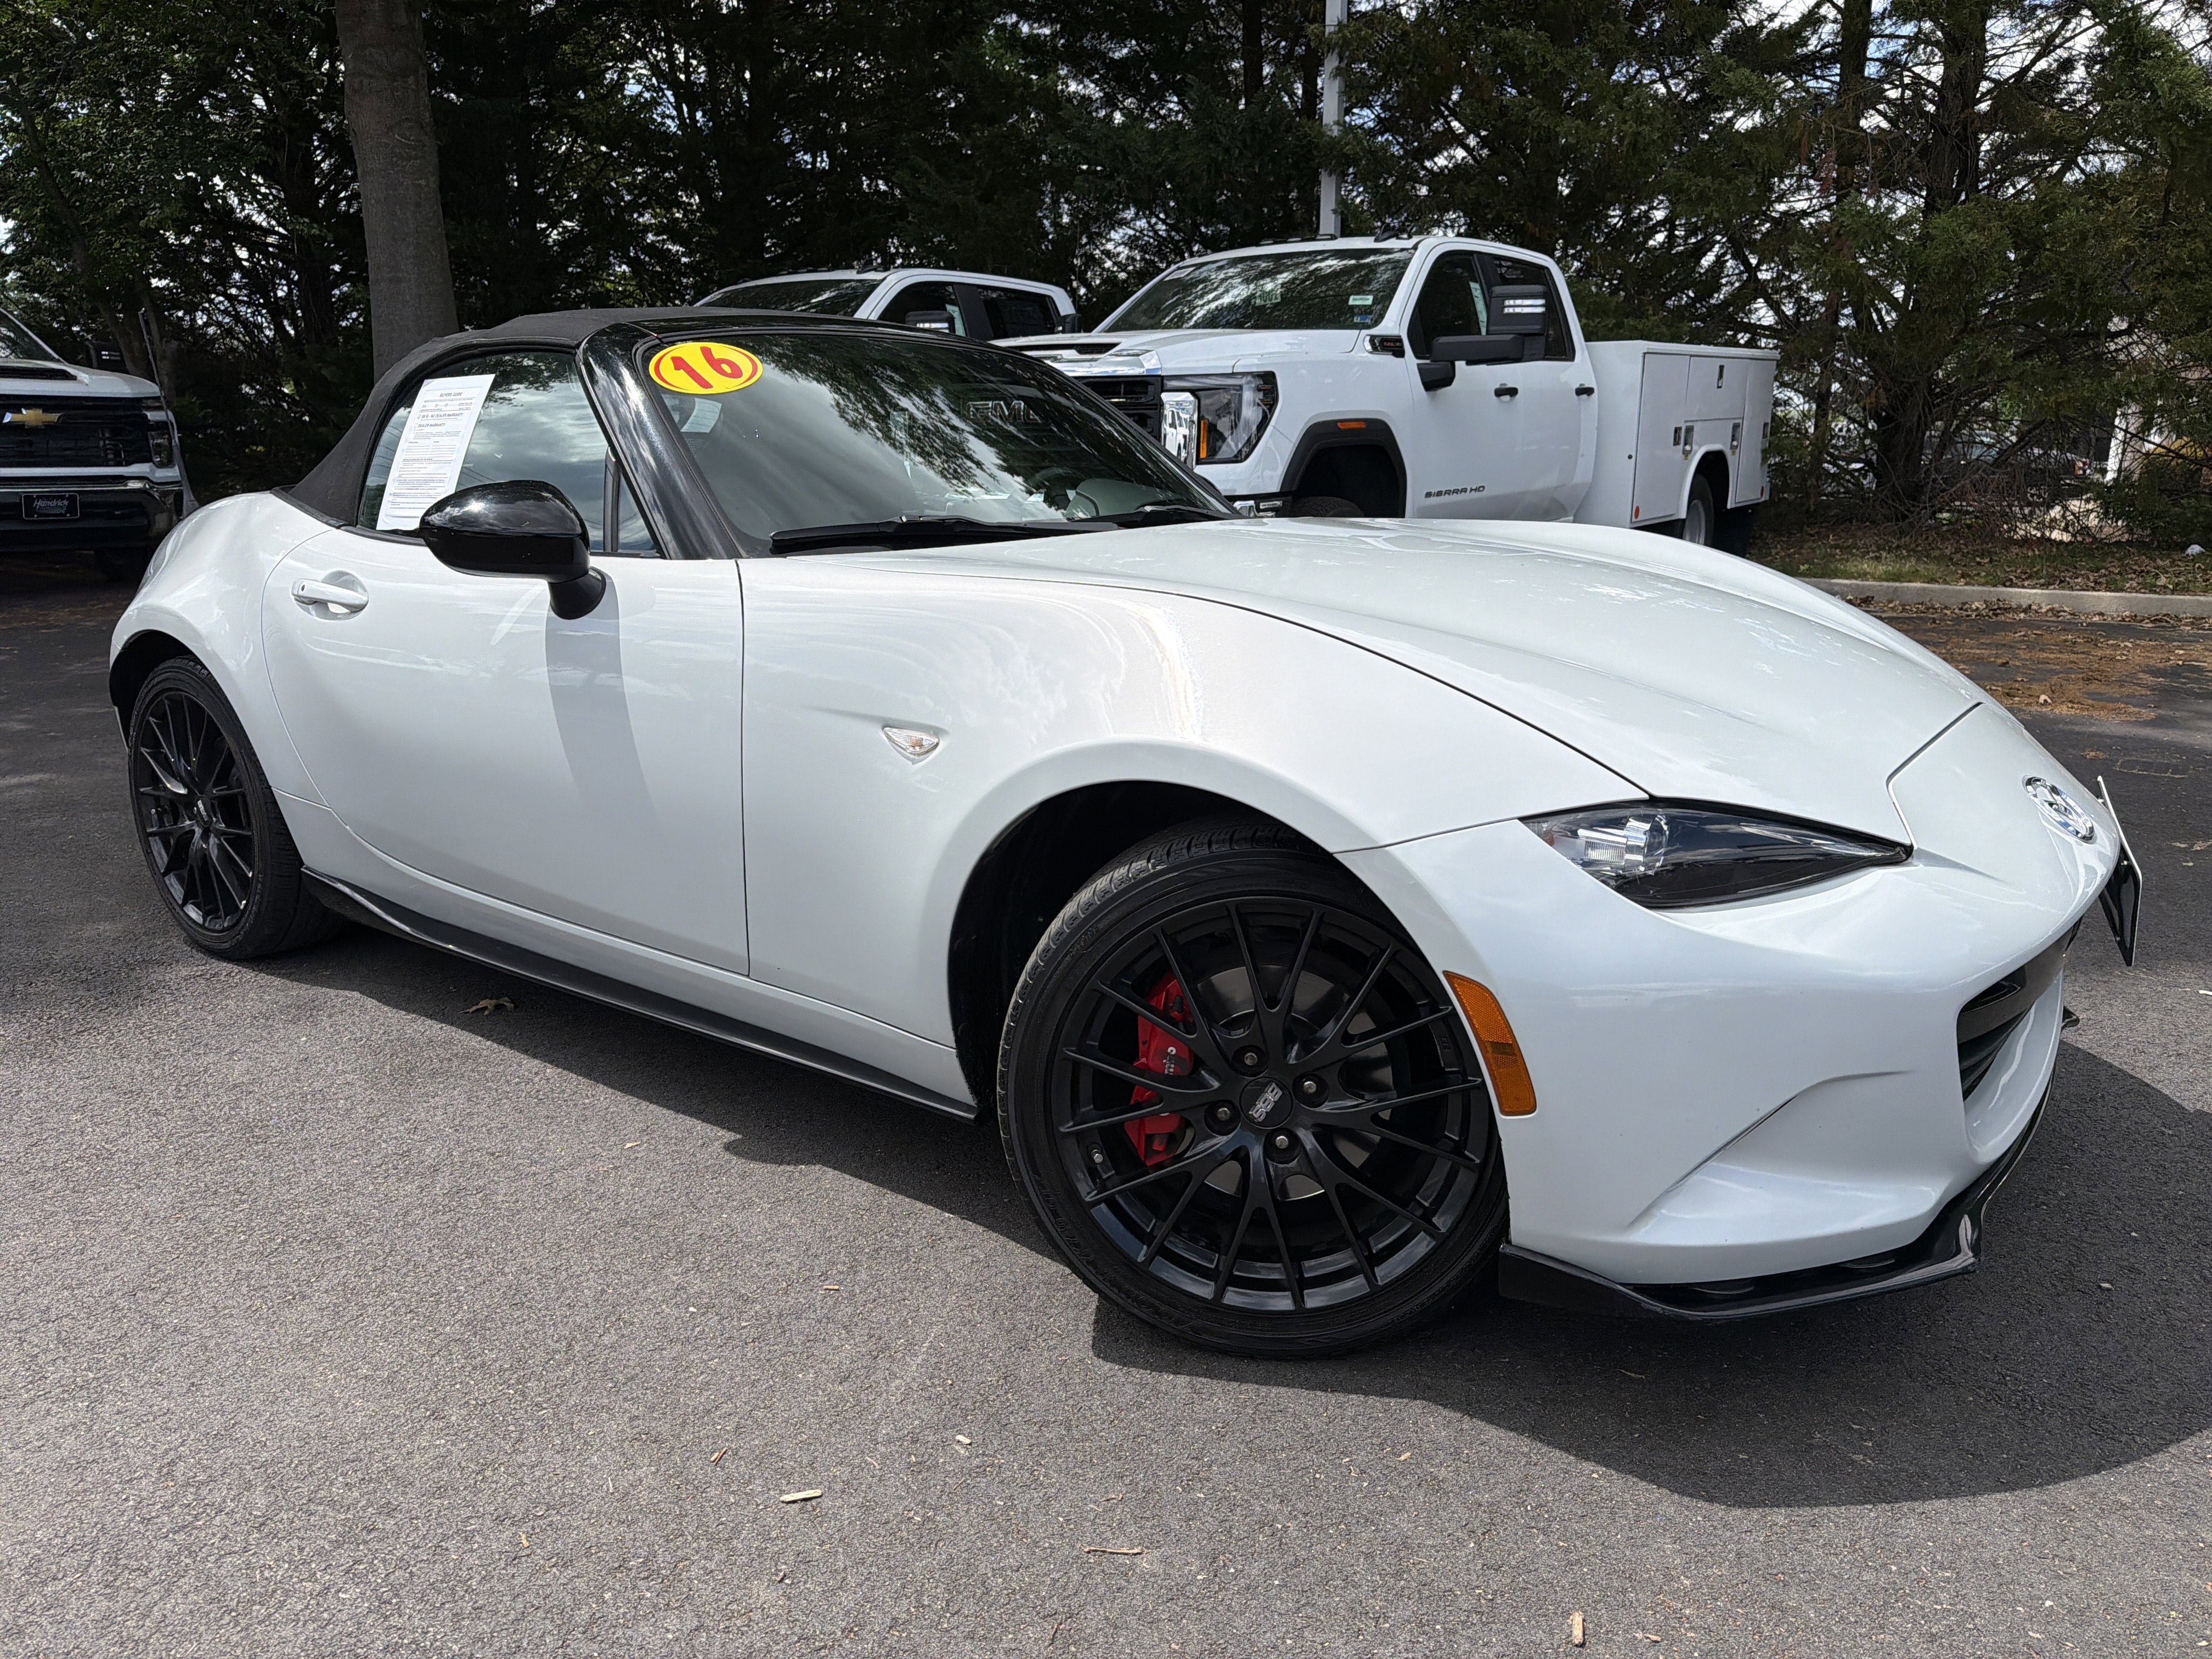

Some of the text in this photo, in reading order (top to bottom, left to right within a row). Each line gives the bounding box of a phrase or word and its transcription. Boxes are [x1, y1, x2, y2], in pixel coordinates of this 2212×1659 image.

[670, 346, 743, 389] 16
[1425, 487, 1468, 498] SIERRA
[1250, 1082, 1283, 1122] BBS
